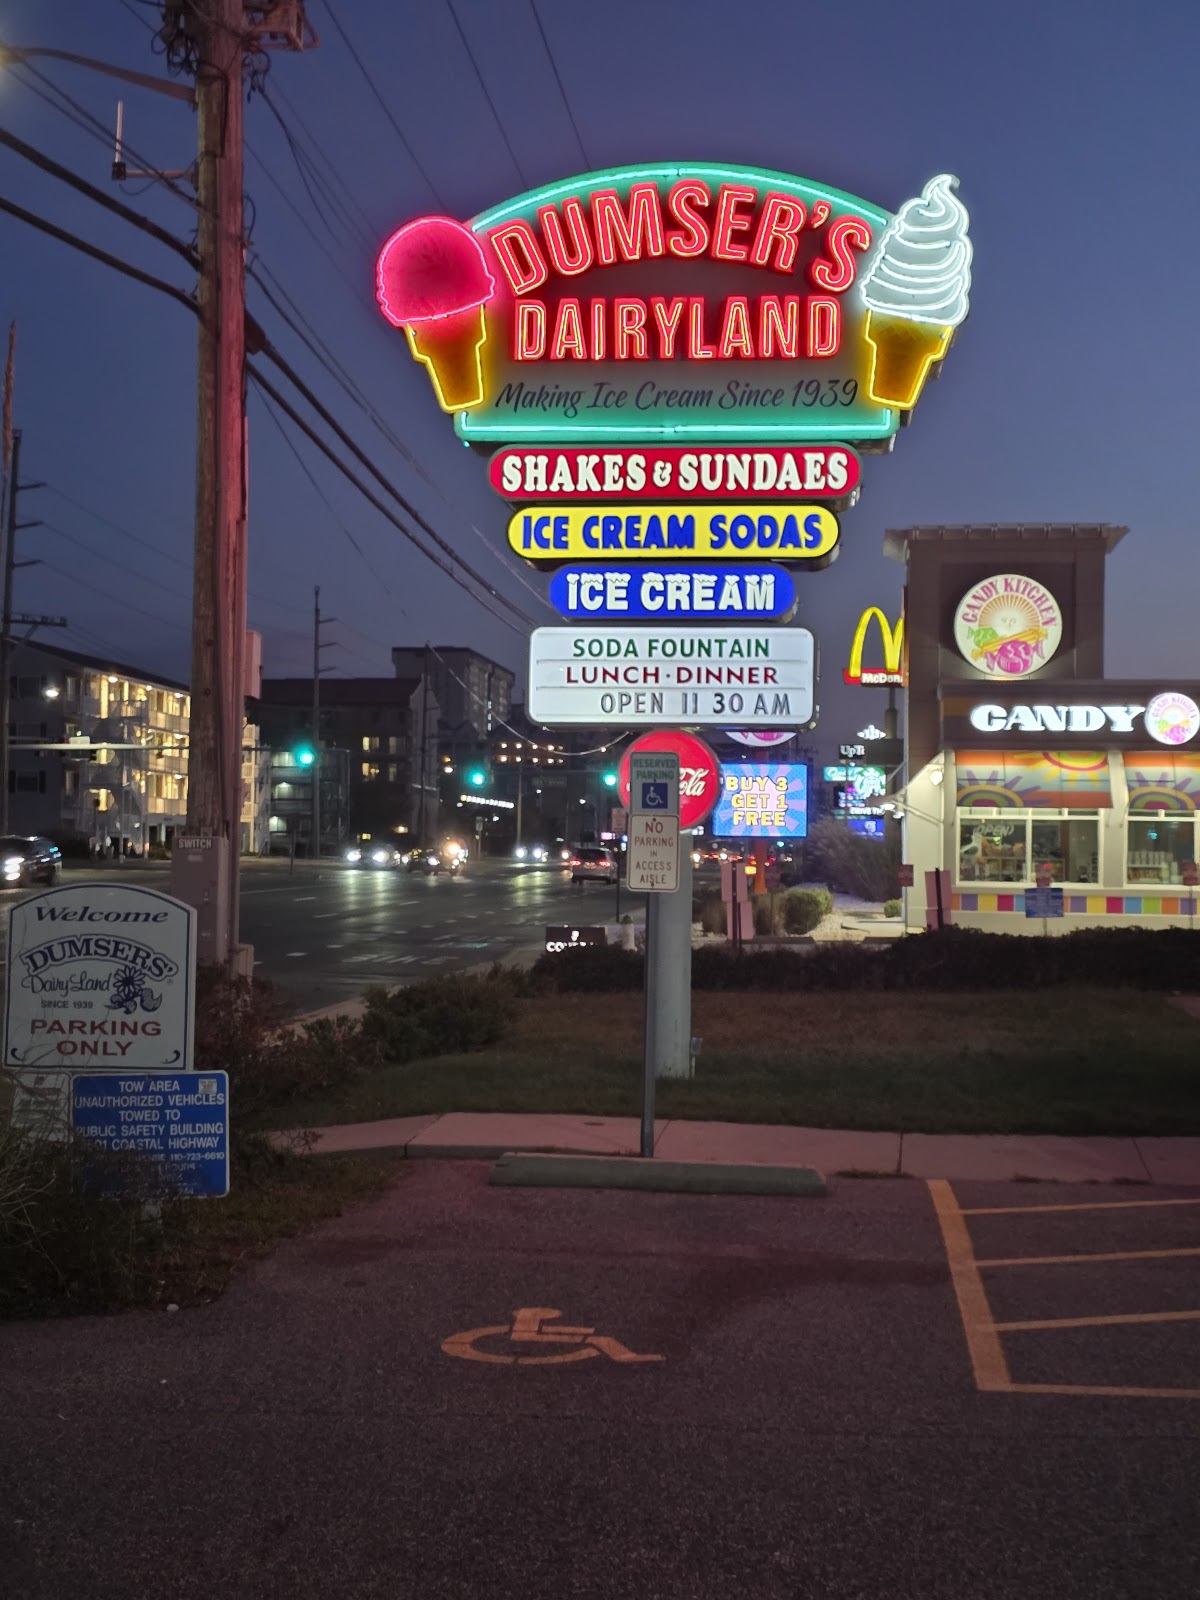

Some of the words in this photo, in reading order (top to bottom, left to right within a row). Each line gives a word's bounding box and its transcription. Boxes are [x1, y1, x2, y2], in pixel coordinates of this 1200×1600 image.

[489, 179, 871, 295] DUMSER'S
[515, 295, 841, 360] DAIRYLAND
[495, 382, 586, 418] Making
[586, 382, 628, 409] Ice
[635, 381, 711, 410] Cream
[718, 380, 785, 409] Since
[791, 379, 858, 408] 1939
[502, 454, 646, 492] SHAKES
[653, 461, 671, 487] &
[678, 452, 848, 491] SUNDAES
[522, 515, 569, 549] ICE
[582, 514, 695, 549] CREAM
[709, 514, 822, 549] SODAS
[567, 572, 631, 611] ICE
[640, 572, 775, 611] CREAM
[961, 577, 1001, 624] CANDY
[1003, 577, 1057, 627] KITCHEN
[573, 638, 639, 657] SODA
[648, 638, 770, 658] FOUNTAIN
[600, 693, 663, 714] OPEN
[713, 693, 744, 714] 30
[754, 693, 791, 715] AM
[970, 704, 1146, 732] CANDY
[633, 759, 676, 768] RESERVED
[637, 770, 675, 780] PARKING
[726, 776, 769, 791] BUY
[776, 776, 788, 791] 3
[731, 793, 770, 809] GET
[777, 794, 788, 809] 1
[733, 811, 786, 826] FREE
[645, 821, 664, 833] NO
[179, 839, 211, 849] SWITCH
[634, 836, 674, 847] PARKING
[636, 861, 672, 871] ACCESS
[640, 874, 667, 884] AISLE
[35, 906, 169, 923] Welcome
[26, 937, 174, 977] DUMSERS'
[41, 1000, 69, 1009] SINCE
[73, 1001, 93, 1009] 1939
[30, 1019, 162, 1035] PARKING
[56, 1041, 133, 1056] ONLY
[119, 1081, 144, 1093] TOW
[149, 1080, 180, 1092] AREA
[75, 1095, 163, 1109] UNAUTHORIZED
[169, 1094, 224, 1106] VEHICLES
[119, 1111, 160, 1122] TOWED
[165, 1110, 180, 1121] TO
[76, 1125, 116, 1138] PUBLIC
[121, 1124, 164, 1137] SAFETY
[170, 1122, 223, 1135] BUILDING
[112, 1139, 163, 1151] COASTAL
[169, 1136, 219, 1149] HIGHWAY
